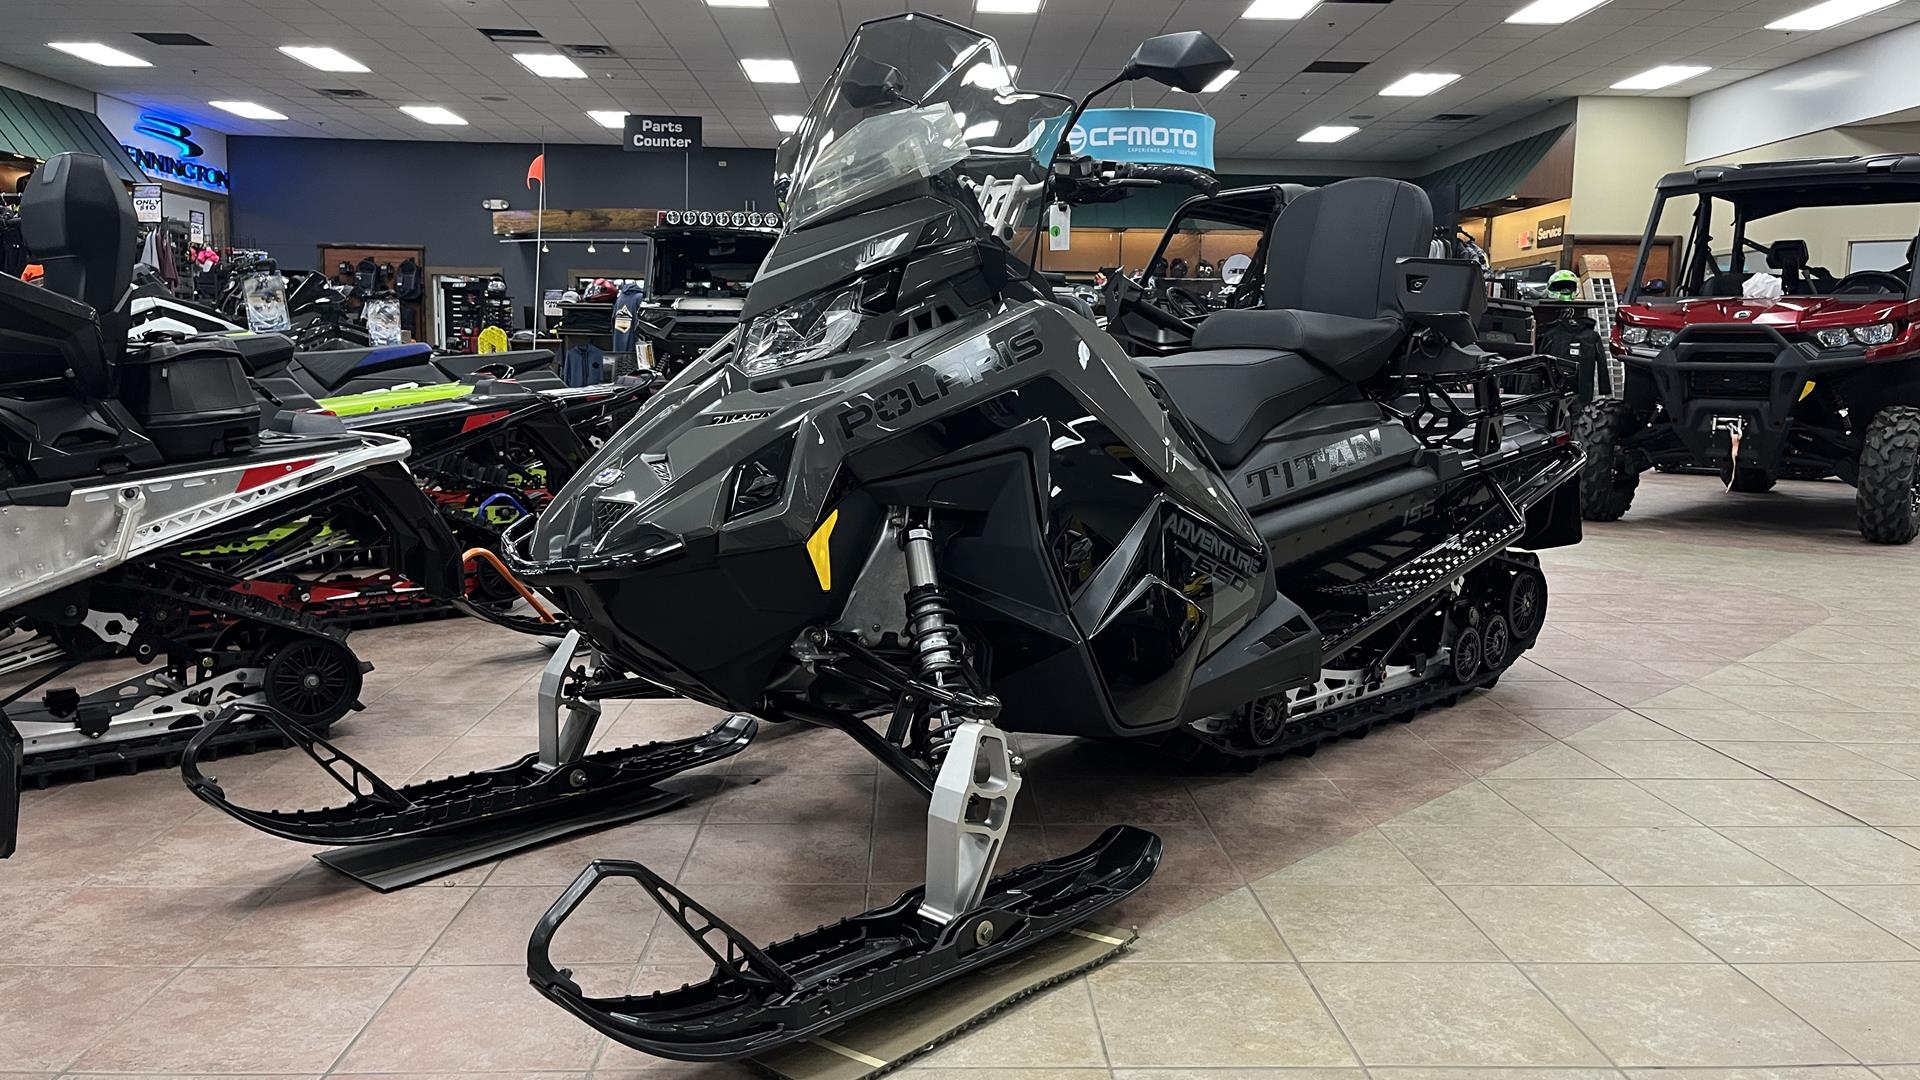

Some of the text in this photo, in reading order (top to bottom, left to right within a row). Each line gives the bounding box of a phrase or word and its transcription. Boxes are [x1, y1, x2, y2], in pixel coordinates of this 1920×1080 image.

[642, 119, 683, 133] Parts
[1089, 126, 1197, 149] CFMOTO
[633, 134, 692, 148] Counter
[120, 144, 230, 188] ENNINGTON
[1537, 225, 1562, 241] Service
[837, 328, 1045, 441] POLARIS
[1243, 428, 1383, 499] TITAN
[1402, 500, 1436, 527] 155
[1163, 511, 1261, 578] ADVENTURE
